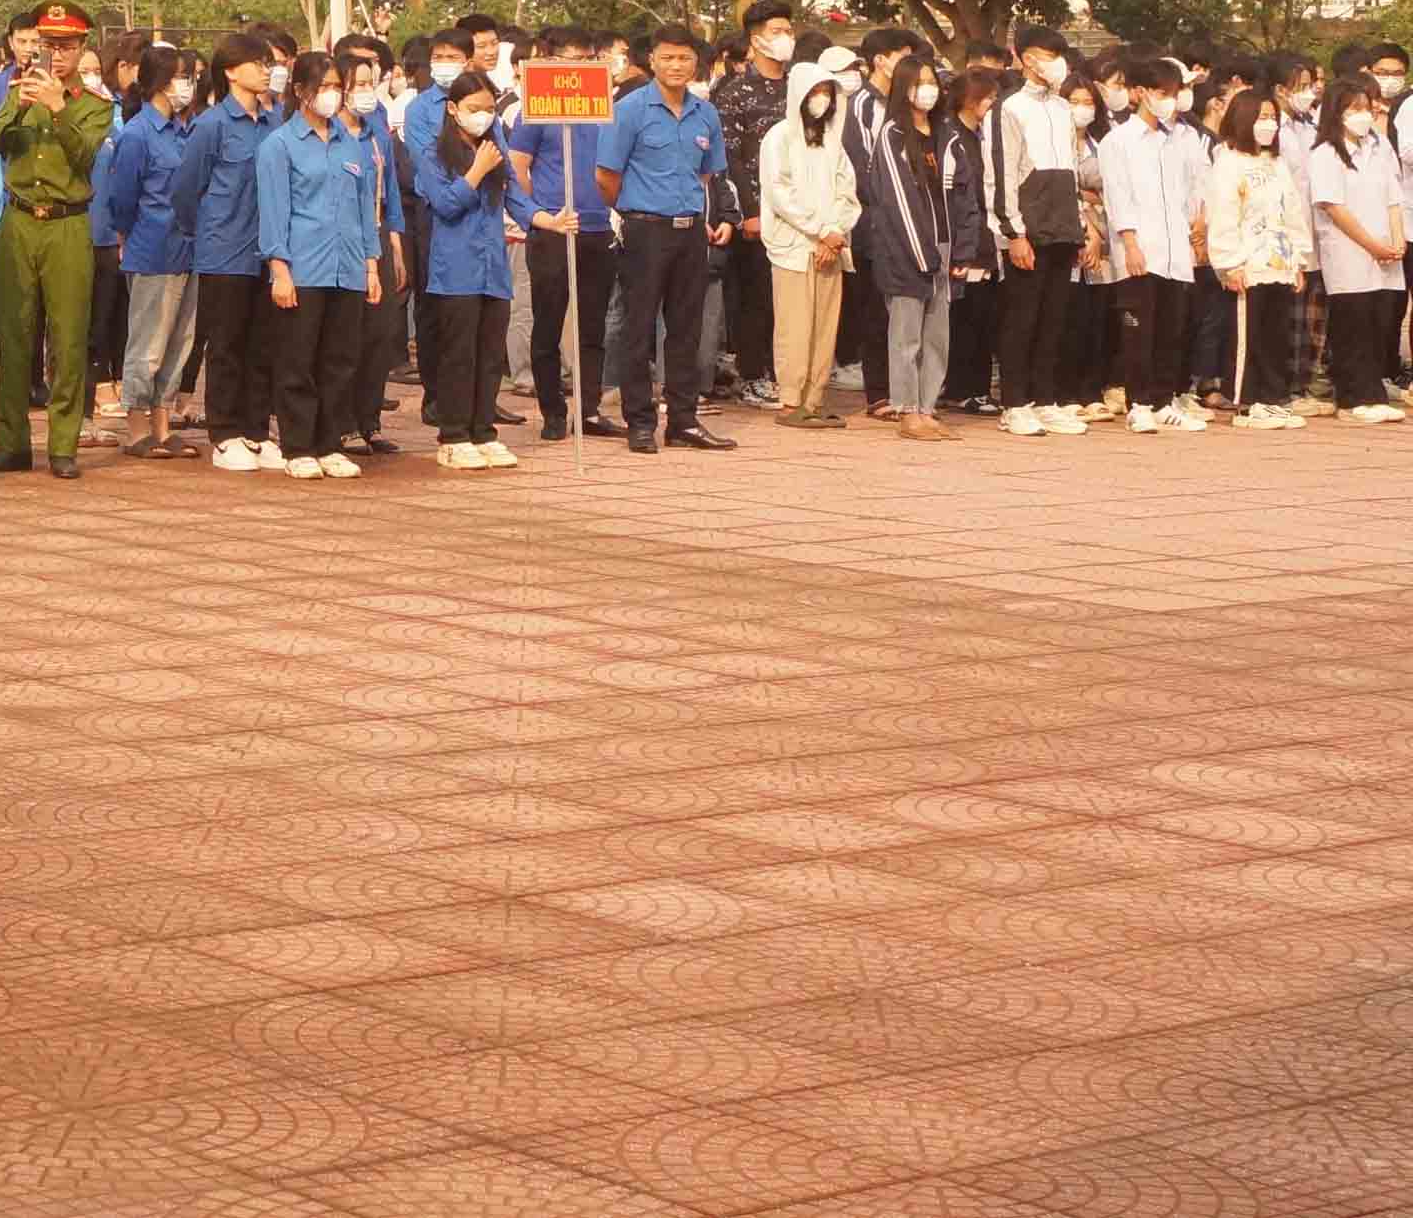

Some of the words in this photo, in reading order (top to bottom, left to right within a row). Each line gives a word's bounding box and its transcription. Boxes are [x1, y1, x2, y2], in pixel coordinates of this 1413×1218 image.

[554, 71, 581, 89] KHỐI
[529, 92, 561, 115] ĐOÀN
[564, 93, 589, 115] VIÊN
[592, 95, 608, 115] TN
